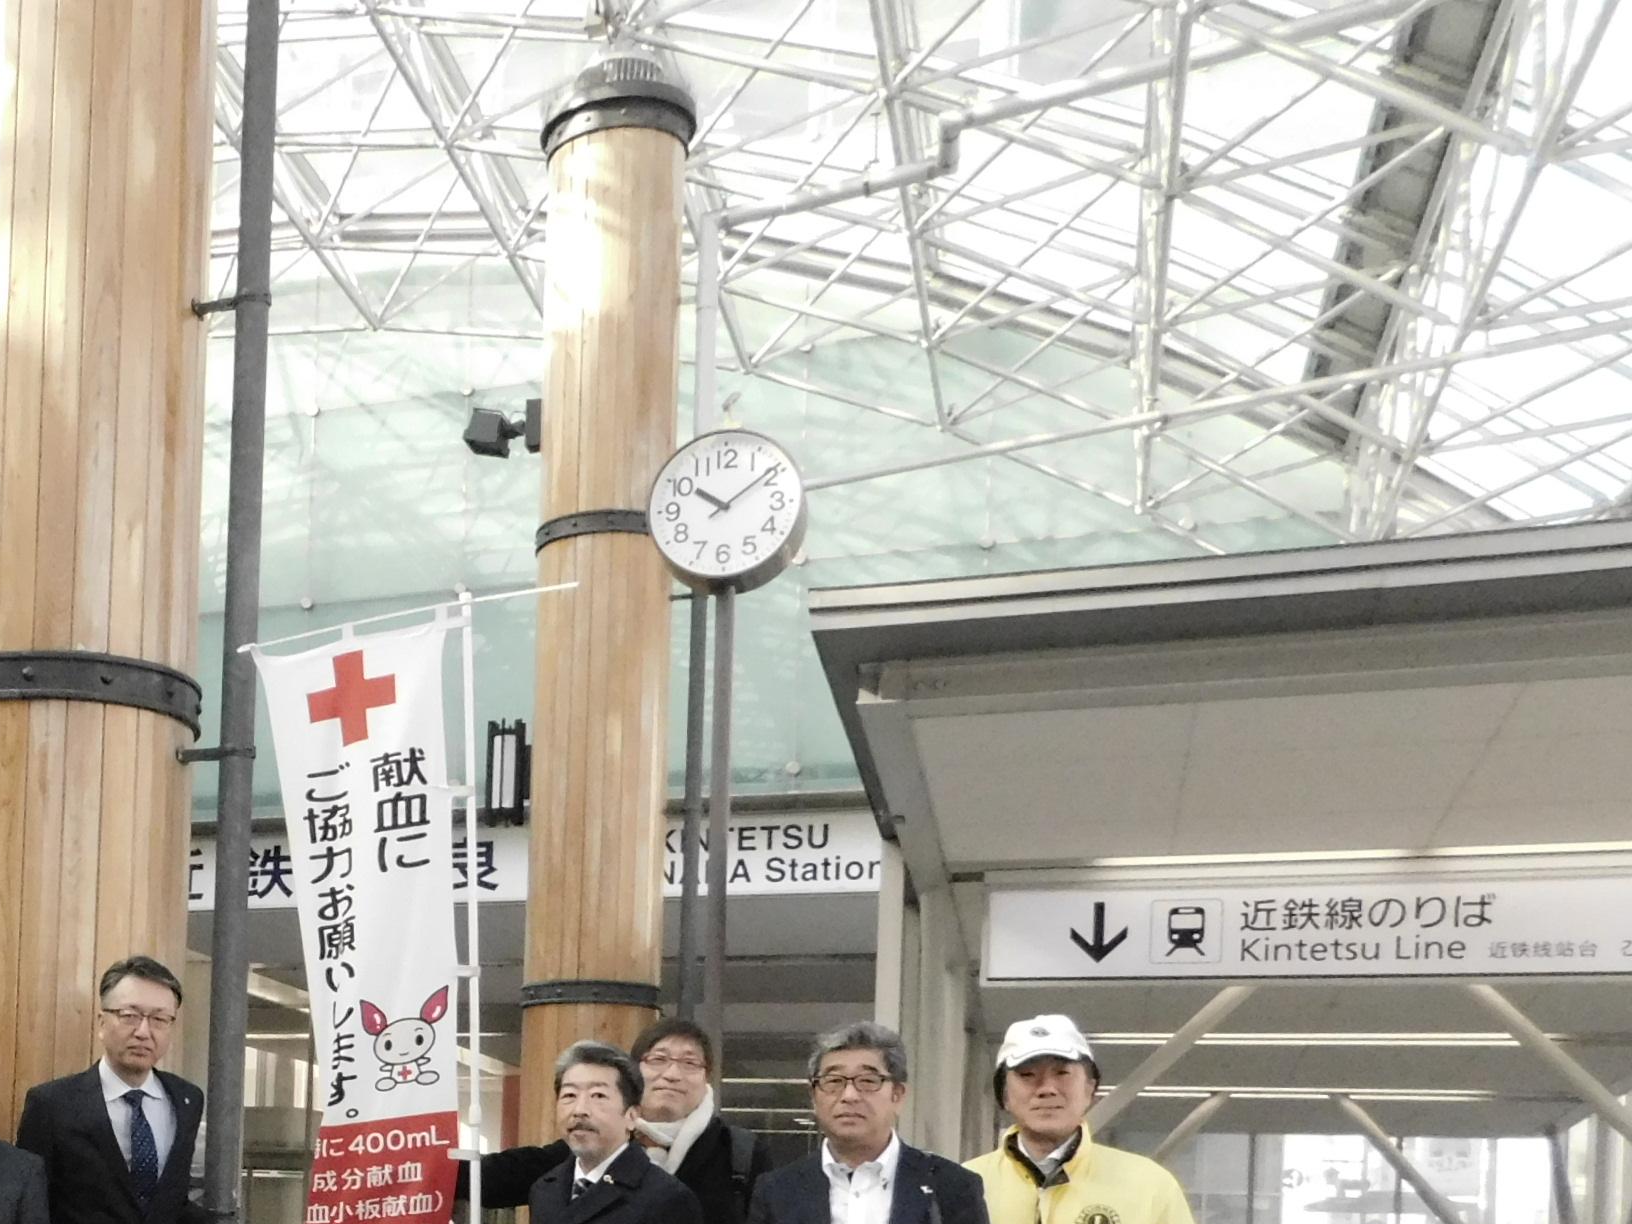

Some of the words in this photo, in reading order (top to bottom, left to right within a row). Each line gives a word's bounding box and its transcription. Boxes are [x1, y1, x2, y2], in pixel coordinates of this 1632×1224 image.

[695, 456, 710, 477] 11
[716, 449, 738, 469] 12
[672, 476, 694, 497] 10
[763, 465, 779, 487] 2
[769, 490, 785, 511] 3
[665, 502, 680, 522] 9
[673, 522, 688, 543] 8
[760, 515, 776, 535] 4
[693, 540, 708, 560] 7
[715, 544, 731, 564] 6
[741, 535, 757, 555] 5
[369, 747, 431, 873] 献血に
[1240, 894, 1497, 932] 近鉄線のりば
[303, 760, 359, 1119] ご協力お願いします。
[1240, 937, 1381, 962] Kintetsu
[1395, 934, 1467, 960] Line
